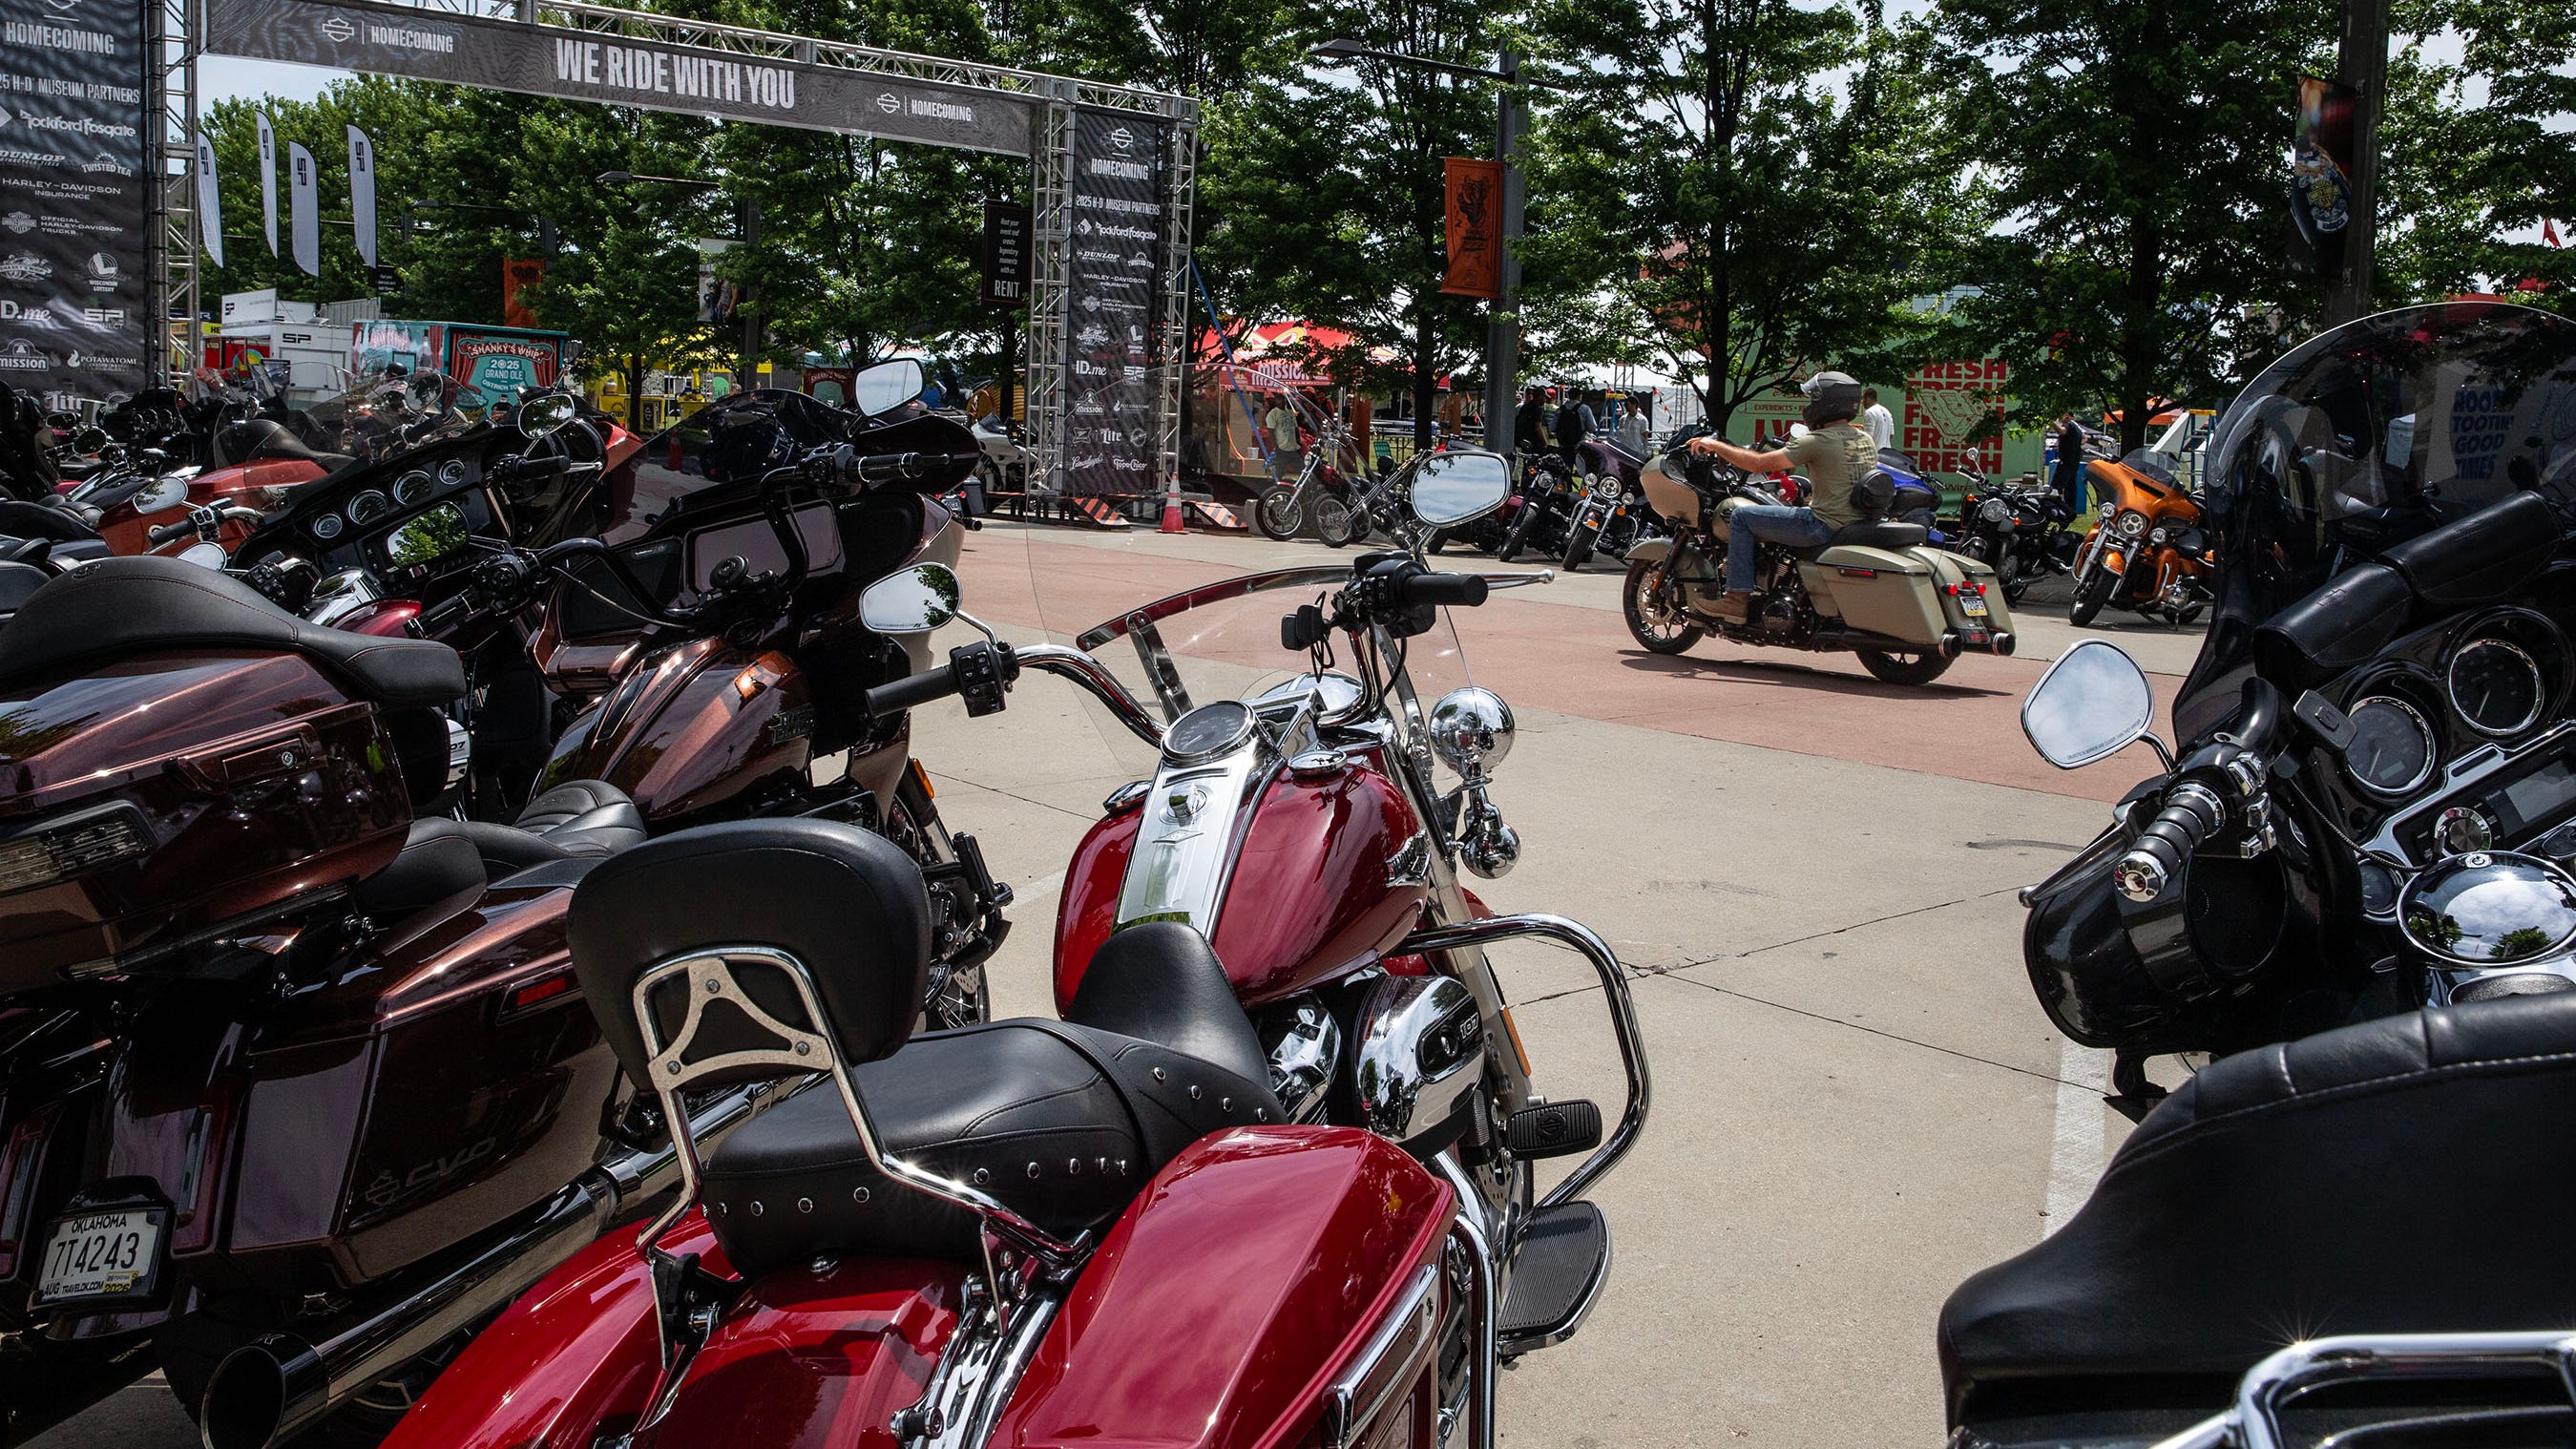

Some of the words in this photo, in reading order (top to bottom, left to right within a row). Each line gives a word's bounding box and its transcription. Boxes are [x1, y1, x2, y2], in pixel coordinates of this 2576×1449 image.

[6, 21, 115, 54] HOMECOMING
[370, 25, 453, 53] HOMECOMING
[555, 37, 599, 85] WE
[607, 45, 668, 94] RIDE
[673, 54, 741, 101] WITH
[744, 64, 795, 110] YOU
[38, 78, 85, 98] MUSEUM
[88, 84, 140, 104] PARTNERS
[911, 99, 972, 122] HOMECOMING
[0, 150, 66, 162] DUNLOP
[81, 163, 116, 174] TWISTED
[116, 166, 132, 178] TEA
[1091, 158, 1149, 180] HOMECOMING
[34, 190, 91, 200] INSURANCE
[1076, 195, 1092, 208] 2025
[1106, 198, 1131, 212] MUSEUM
[1131, 201, 1161, 216] PARTNERS
[40, 215, 80, 223] OFFICIAL
[41, 221, 123, 232] HARLEY-DAVIDSON
[41, 227, 76, 236] TRUCKS
[1082, 251, 1120, 260] DUNLOP
[994, 280, 1020, 298] RENT
[0, 300, 52, 322] D.me
[84, 307, 124, 323] SP
[283, 333, 312, 344] SP
[471, 343, 516, 356] SHANKY'S
[518, 345, 540, 360] WHIP
[80, 356, 137, 365] POTAWATOMI
[491, 359, 520, 369] 2025
[1076, 360, 1107, 376] ID.me
[1907, 358, 2007, 380] RESH
[485, 368, 509, 379] GRAND
[510, 370, 524, 380] OLE
[482, 379, 509, 390] OSTRICH
[1100, 428, 1122, 445] Lite
[1903, 428, 2003, 451] FRH
[2454, 433, 2505, 454] GOOD
[2455, 454, 2497, 480] TIMES
[1459, 1012, 1479, 1040] 107
[405, 1136, 496, 1187] CVO
[71, 1214, 127, 1234] OKLAHOMA
[51, 1232, 140, 1279] 7T4243
[44, 1282, 60, 1296] AUG
[62, 1280, 105, 1294] TRAVELOK.COM
